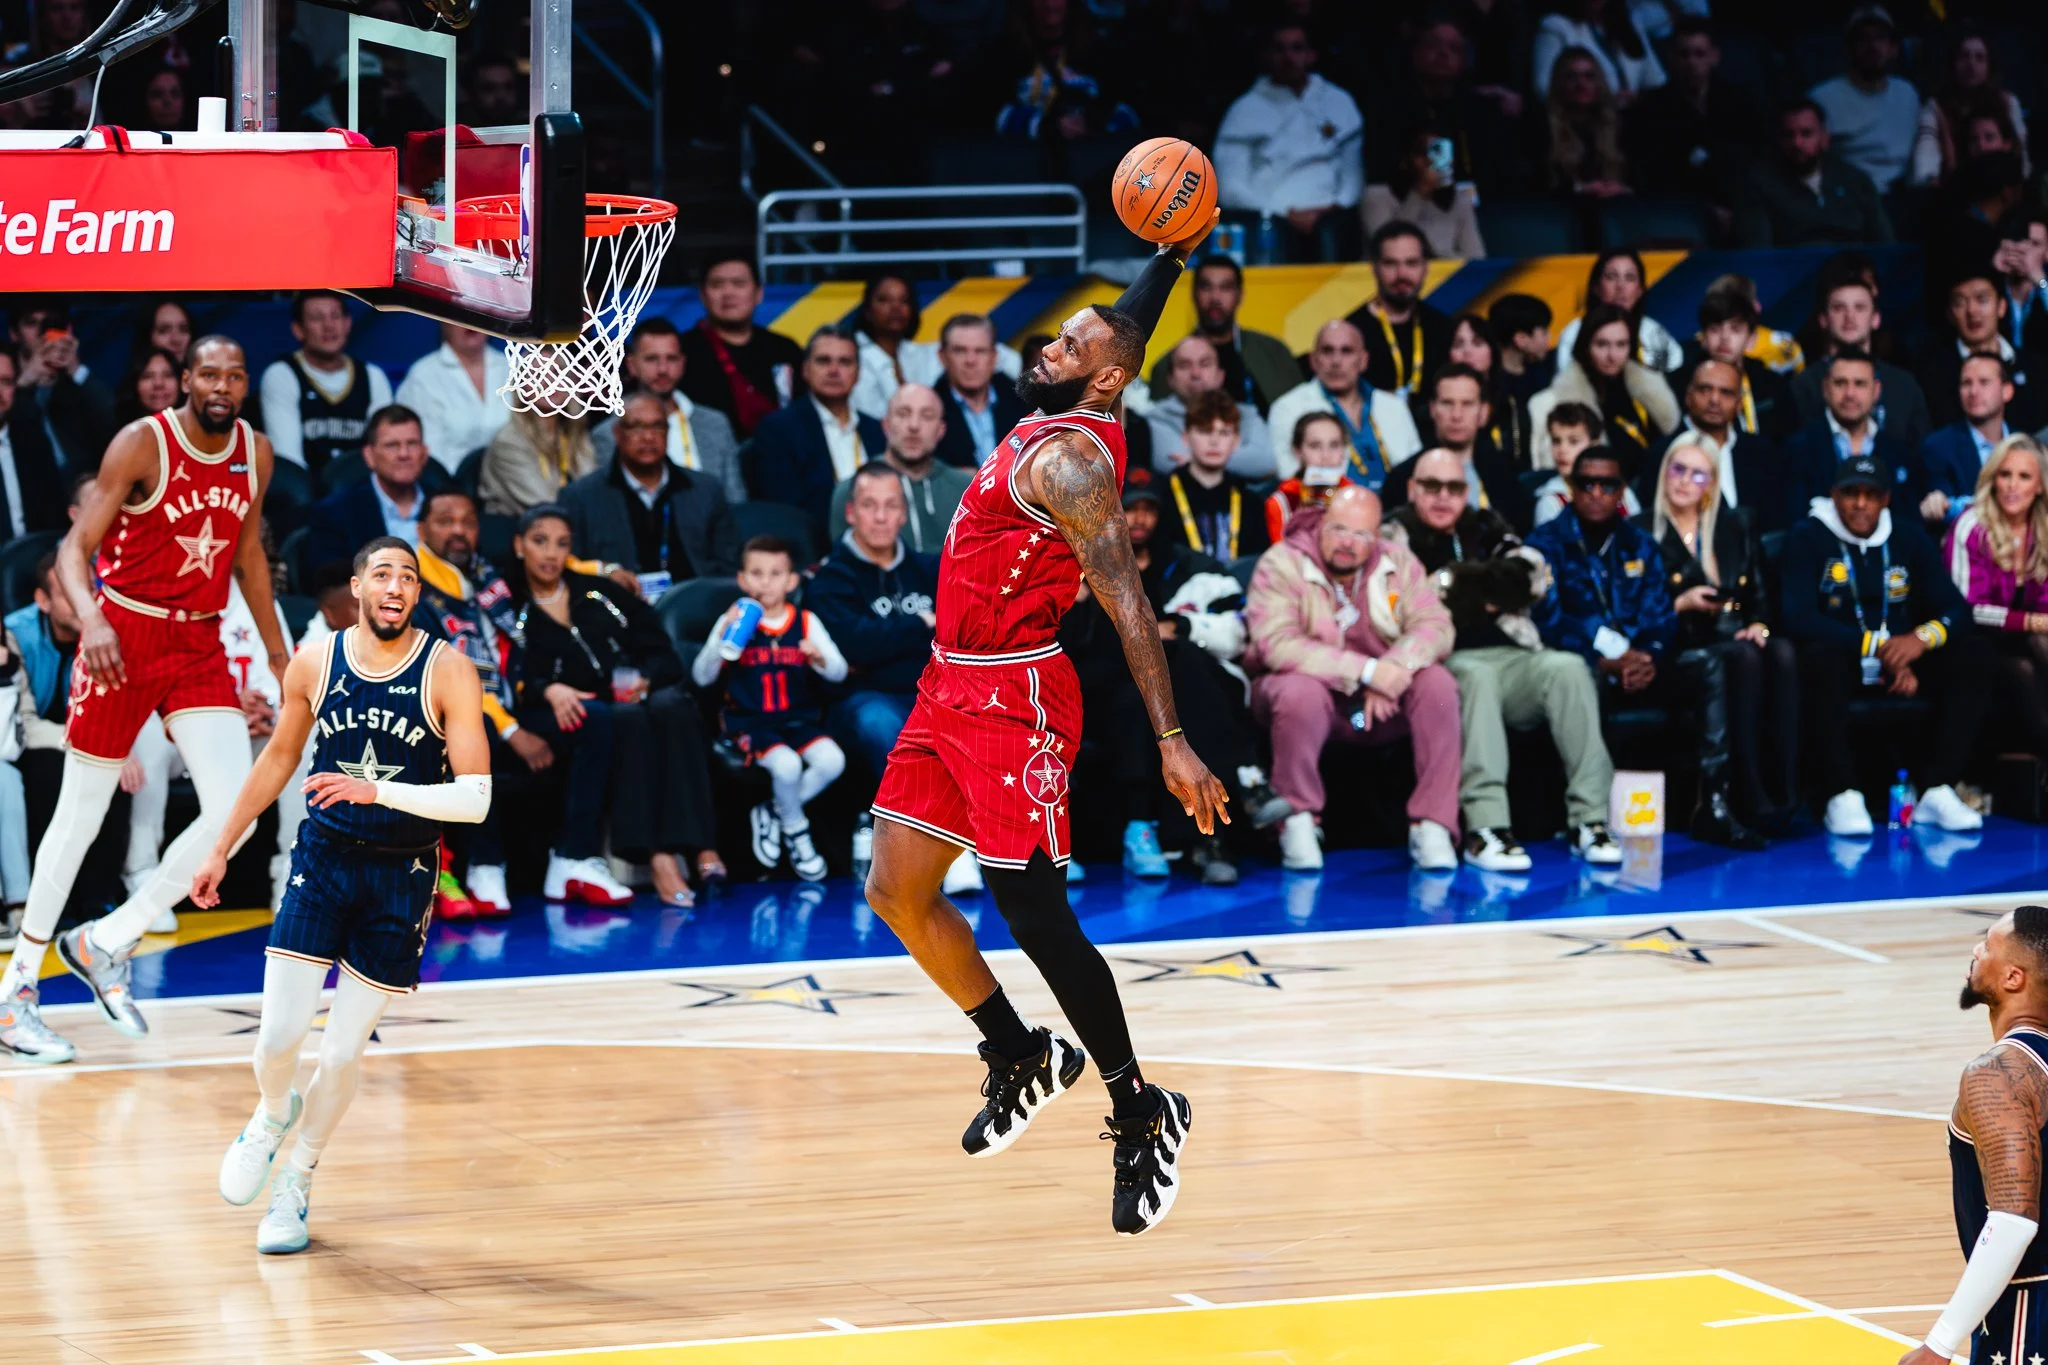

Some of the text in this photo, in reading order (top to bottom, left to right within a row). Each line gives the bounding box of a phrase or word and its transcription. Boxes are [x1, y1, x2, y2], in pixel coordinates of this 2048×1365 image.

[1152, 170, 1201, 229] Wilson
[761, 671, 790, 712] 11
[318, 707, 426, 747] ALL-STAR
